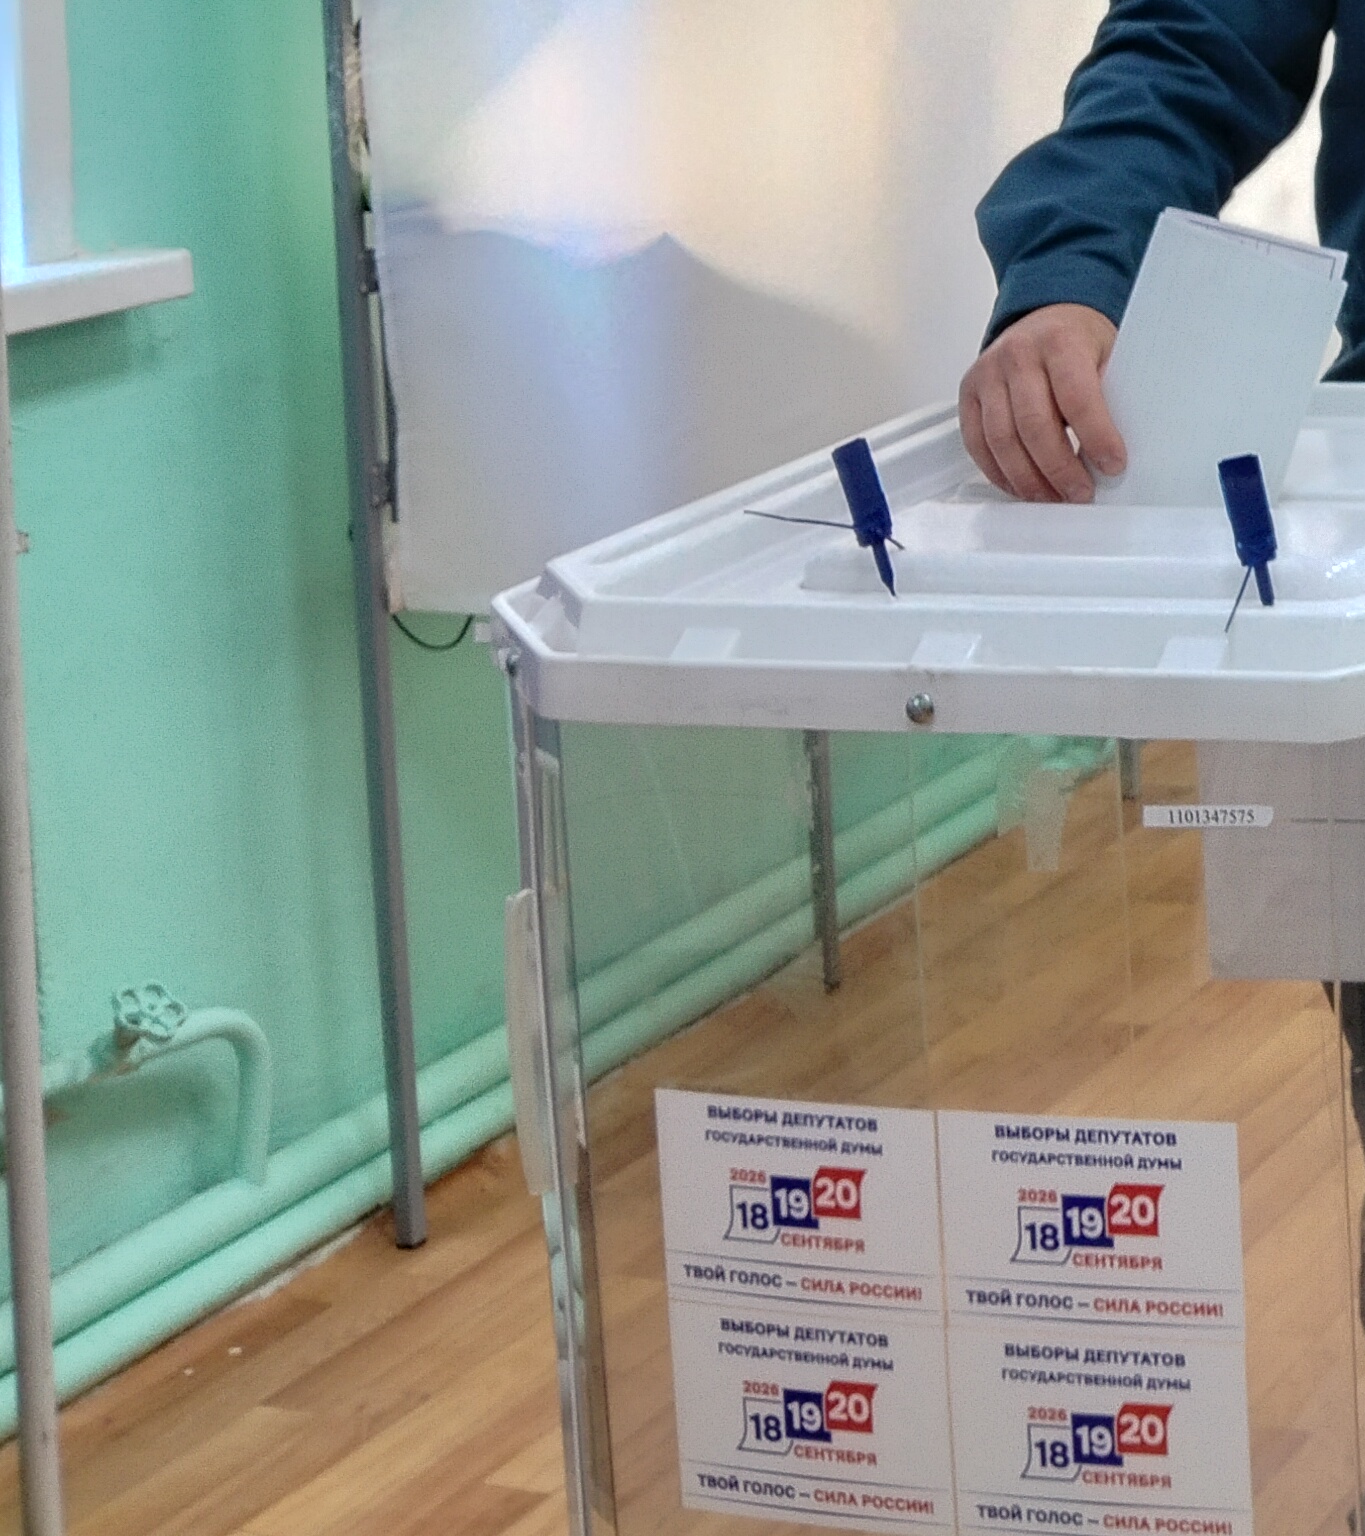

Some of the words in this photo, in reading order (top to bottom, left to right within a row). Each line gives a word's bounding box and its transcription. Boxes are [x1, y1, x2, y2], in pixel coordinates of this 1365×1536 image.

[1169, 809, 1255, 824] 1101347575
[707, 1105, 778, 1124] ВЫБОРЫ
[781, 1112, 878, 1132] ДЕПУТАТОВ
[705, 1129, 837, 1151] ГОСУДАРСТВЕННОЙ
[840, 1143, 883, 1156] ДУМЫ
[994, 1124, 1070, 1141] ВЫБОРЫ
[1074, 1128, 1177, 1147] ДЕПУТАТОВ
[991, 1149, 1134, 1169] ГОСУДАРСТВЕННОЙ
[1136, 1158, 1182, 1171] ДУМЫ
[736, 1202, 769, 1230] 18
[774, 1187, 810, 1219] 19
[813, 1176, 859, 1209] 20
[1025, 1222, 1059, 1251] 18
[1065, 1206, 1102, 1238] 19
[1109, 1194, 1156, 1226] 20
[780, 1232, 865, 1253] СЕНТЯБРЯ
[1072, 1253, 1163, 1270] СЕНТЯБРЯ
[683, 1264, 726, 1281] ТВОЙ
[729, 1271, 782, 1287] ГОЛОС
[801, 1277, 845, 1294] СИЛА
[965, 1289, 1012, 1306] ТВОЙ
[1016, 1293, 1073, 1310] ГОЛОС
[1093, 1297, 1140, 1314] СИЛА
[720, 1318, 790, 1337] ВЫБОРЫ
[794, 1326, 889, 1347] ДЕПУТАТОВ
[718, 1341, 849, 1366] ГОСУДАРСТВЕННОЙ
[852, 1357, 893, 1371] ДУМЫ
[1004, 1343, 1079, 1361] ВЫБОРЫ
[1083, 1348, 1186, 1367] ДЕПУТАТОВ
[1002, 1368, 1142, 1388] ГОСУДАРСТВЕННОЙ
[1146, 1378, 1191, 1391] ДУМЫ
[750, 1413, 782, 1442] 18
[786, 1401, 822, 1433] 19
[827, 1391, 870, 1423] 20
[1035, 1440, 1070, 1468] 18
[1075, 1426, 1113, 1457] 19
[1119, 1414, 1164, 1446] 20
[794, 1445, 877, 1465] СЕНТЯБРЯ
[698, 1473, 740, 1491] ТВОЙ
[743, 1480, 795, 1499] ГОЛОС
[813, 1489, 858, 1507] СИЛА
[1082, 1471, 1171, 1488] СЕНТЯБРЯ
[977, 1504, 1022, 1521] ТВОЙ
[1027, 1508, 1083, 1526] ГОЛОС
[1103, 1513, 1150, 1531] СИЛА
